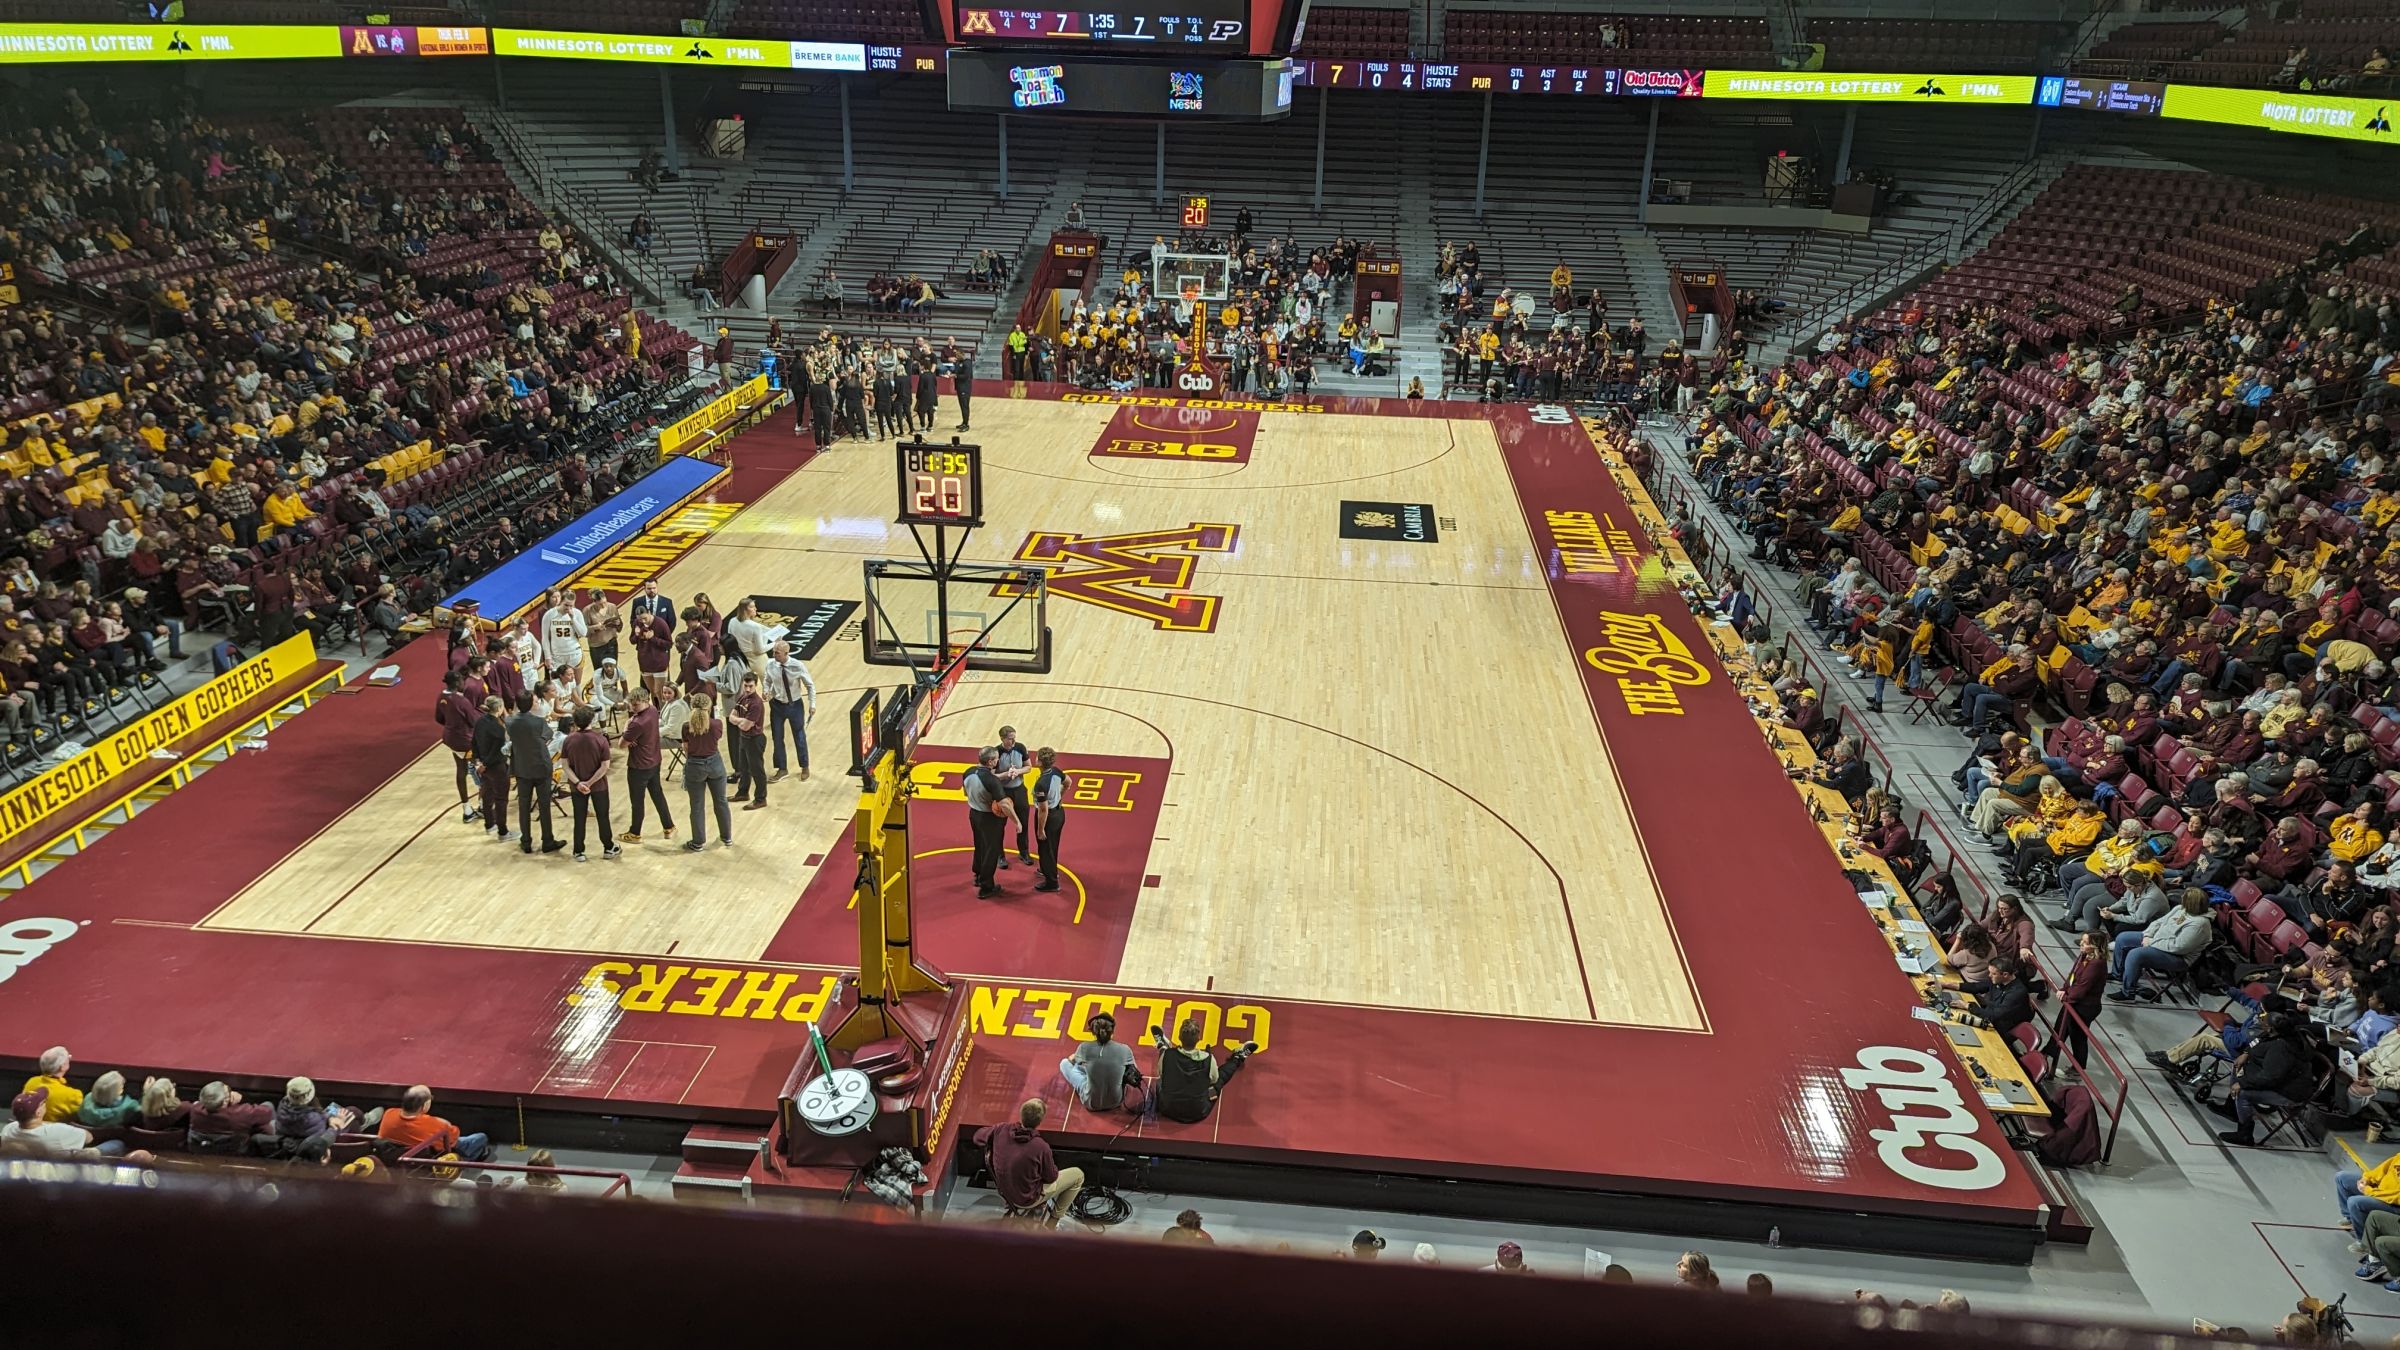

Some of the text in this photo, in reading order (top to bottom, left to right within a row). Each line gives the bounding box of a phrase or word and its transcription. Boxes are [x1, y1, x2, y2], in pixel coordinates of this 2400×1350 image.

[1021, 12, 1042, 20] FOULS
[1056, 14, 1068, 33] 7
[1088, 13, 1115, 30] 1:35
[1159, 16, 1180, 24] FOULS
[1003, 19, 1011, 30] 4
[1029, 19, 1036, 31] 3
[1134, 17, 1145, 35] 7
[1167, 23, 1174, 34] 0
[1191, 24, 1198, 35] 4
[1094, 32, 1107, 40] 1ST
[0, 36, 153, 52] INNESOTA LOTTERY
[517, 37, 673, 57] MINNESOTA LOTTERY
[794, 51, 860, 64] BREMER BANK
[871, 46, 902, 58] HUSTLE
[872, 58, 897, 69] STATS
[916, 59, 935, 71] PUR
[1367, 63, 1389, 73] FOULS
[1426, 65, 1459, 76] HUSTLE
[1010, 65, 1063, 84] Cinnamon
[1331, 65, 1343, 83] 7
[1372, 73, 1381, 88] 0
[1510, 68, 1525, 78] STL
[1540, 69, 1556, 79] AST
[1572, 69, 1588, 79] BLK
[1605, 70, 1616, 80] TO
[1624, 70, 1682, 88] Old Dutch
[1021, 77, 1054, 93] Toast
[1402, 74, 1412, 89] 4
[1426, 78, 1452, 89] STATS
[1471, 77, 1491, 89] PUR
[1512, 79, 1519, 91] 0
[1543, 80, 1550, 92] 3
[1575, 80, 1583, 92] 2
[1605, 81, 1613, 93] 3
[1728, 78, 1902, 96] MINNESOTA LOTTERY
[1014, 84, 1065, 107] Crunch
[1632, 88, 1651, 96] Quality
[2262, 102, 2356, 128] MIOTA LOTTERY
[1190, 198, 1208, 209] 1:35
[1185, 207, 1205, 225] 20
[1193, 302, 1203, 361] MINNESOTA
[1179, 374, 1214, 391] Cub
[1061, 393, 1324, 413] GOLDEN GOPHERS
[677, 409, 711, 443] MINNESOTA
[711, 398, 733, 423] GOLDEN
[916, 475, 962, 513] 20
[559, 495, 660, 555] UnitedHealthcare
[569, 502, 745, 593] MINNESOTA
[1544, 510, 1620, 573] WILLIAMS
[1606, 530, 1640, 557] ARENA
[556, 628, 570, 638] 52
[520, 651, 532, 664] 25
[1585, 611, 1711, 716] THE Barn
[0, 657, 274, 841] INNESOTA GOLDEN GOPHERS
[969, 986, 1272, 1054] GOLDEN
[927, 1037, 975, 1155] GOPHERSPORTS.com
[1840, 1046, 2007, 1190] Cub
